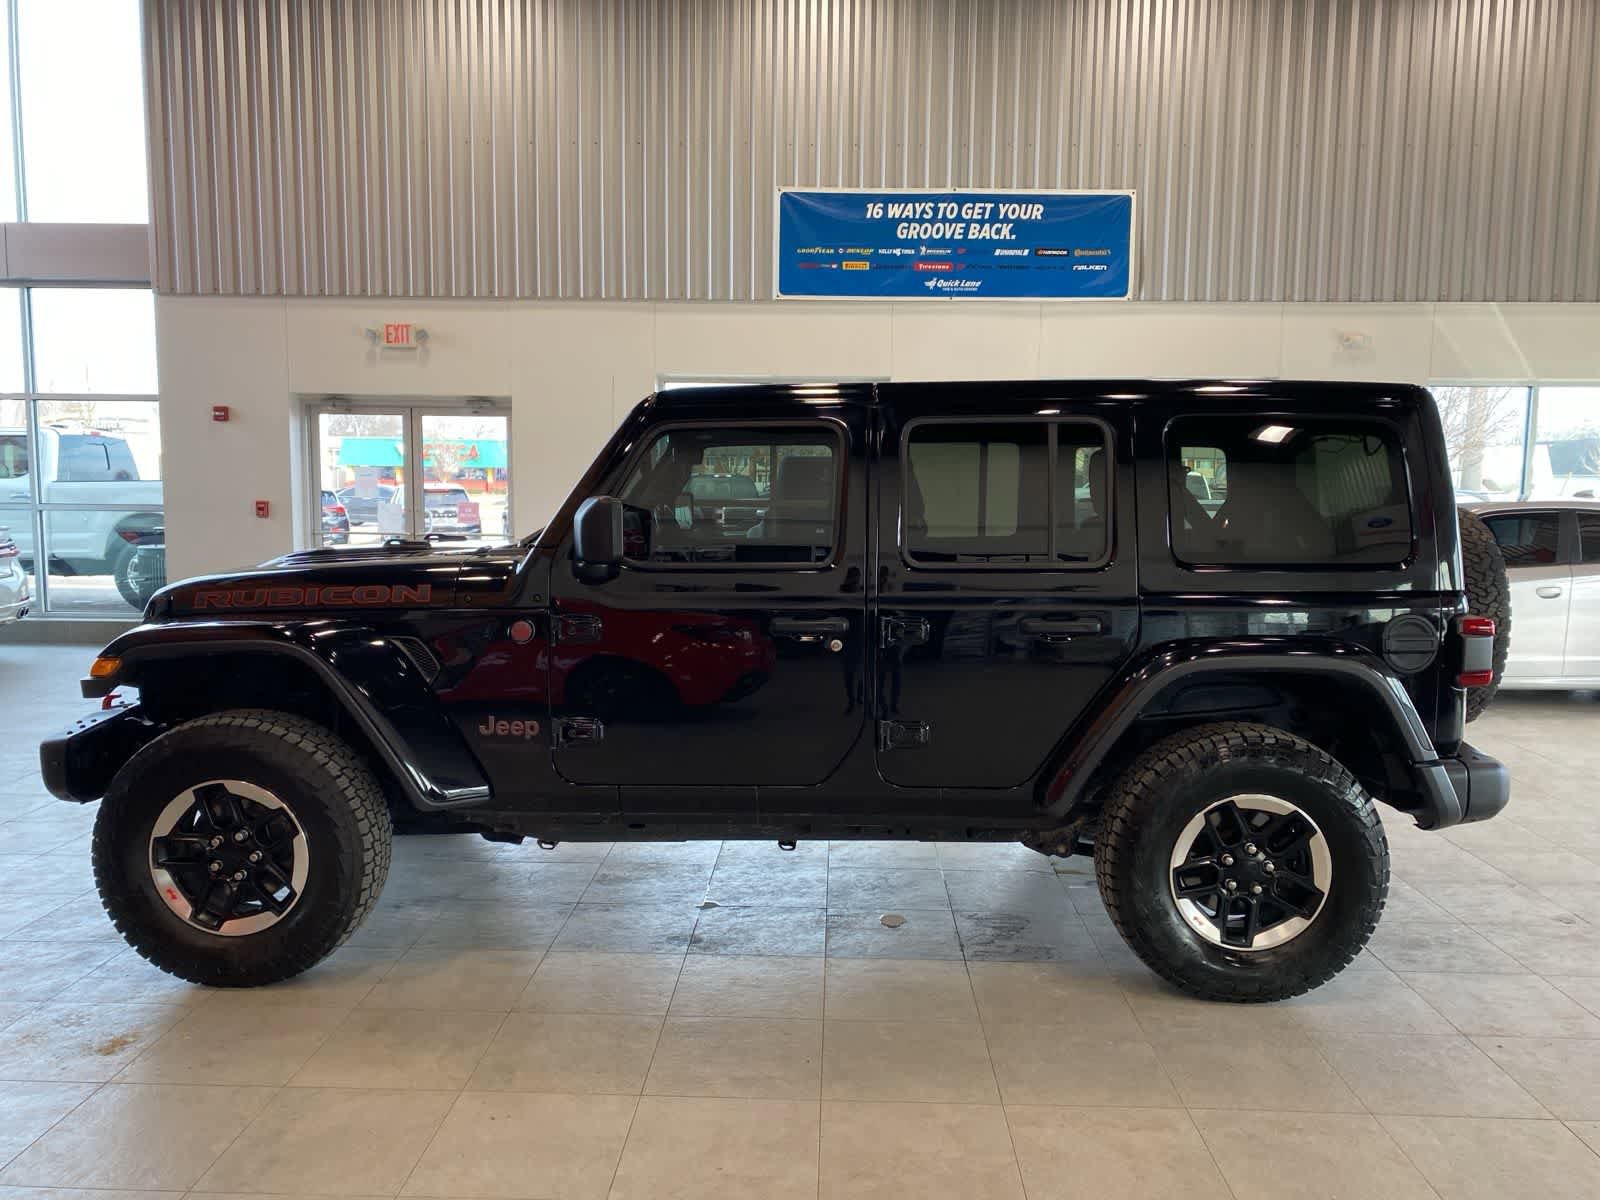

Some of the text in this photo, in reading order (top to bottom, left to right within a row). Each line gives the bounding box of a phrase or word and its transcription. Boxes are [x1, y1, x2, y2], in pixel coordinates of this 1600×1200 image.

[866, 203, 1044, 220] 16 WAYS TO GET YOUR
[896, 223, 1016, 240] GROOVE BACK.
[936, 279, 982, 288] Quick Lane
[385, 324, 411, 344] EXIT
[193, 583, 432, 609] RUBICON
[479, 715, 539, 739] Jeep
